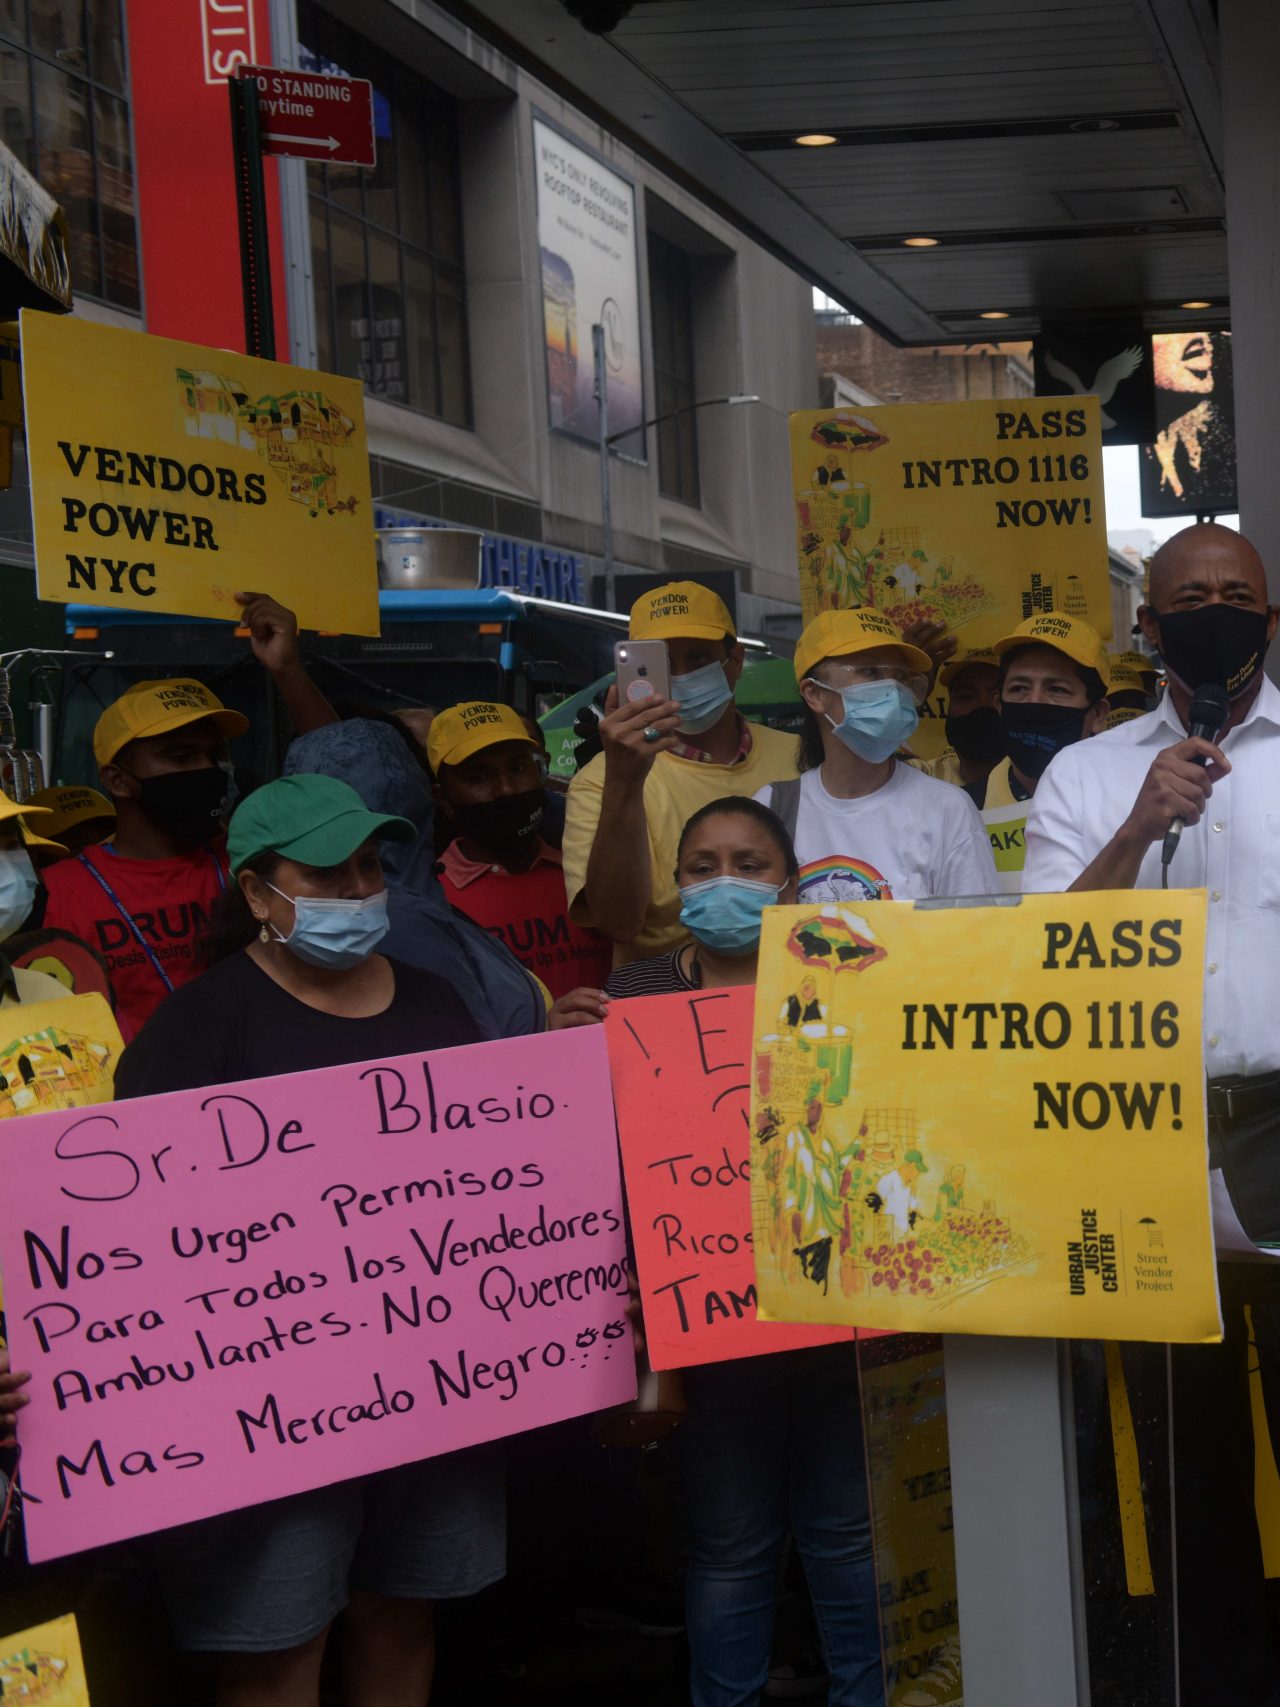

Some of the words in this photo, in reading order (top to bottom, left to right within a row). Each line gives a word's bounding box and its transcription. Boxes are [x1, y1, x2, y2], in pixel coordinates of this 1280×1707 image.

[273, 78, 351, 102] STANDING
[258, 98, 314, 117] nytime
[996, 410, 1087, 440] PASS
[57, 441, 267, 505] VENDORS
[902, 456, 1020, 489] INTRO
[1029, 454, 1090, 483] 1116
[61, 497, 219, 551] POWER
[996, 498, 1092, 528] NOW!
[66, 554, 156, 596] NYC
[480, 535, 588, 605] THEATRE
[650, 593, 689, 607] VENDOR
[650, 605, 689, 620] POWER!
[1023, 591, 1032, 621] RBAN
[1043, 586, 1054, 613] ENTER
[856, 613, 892, 627] VENDOR
[861, 623, 896, 638] POWER!
[1030, 626, 1067, 639] POWER!
[1035, 617, 1073, 631] VENDOR
[459, 704, 499, 719] VENDOR
[463, 714, 503, 731] POWER!
[1042, 919, 1184, 969] PASS
[102, 948, 146, 971] Desis
[902, 1001, 1072, 1050] INTRO
[1086, 1000, 1180, 1049] 1116
[1033, 1082, 1184, 1131] NOW!
[54, 1115, 198, 1201] Sr.
[200, 1095, 315, 1171] De
[24, 1225, 143, 1290] Nos
[171, 1211, 296, 1263] Urgen
[321, 1162, 545, 1227] Permisos
[1081, 1208, 1100, 1275] JUSTICE
[1067, 1242, 1086, 1296] URBAN
[1099, 1234, 1118, 1293] CENTER
[1134, 1266, 1173, 1278] Vendor
[1136, 1252, 1168, 1264] Street
[23, 1302, 164, 1354] Para
[185, 1268, 328, 1315] Todos
[344, 1246, 406, 1284] los
[410, 1204, 620, 1276] Vendedores
[1136, 1279, 1174, 1292] Project
[382, 1285, 453, 1334] No
[478, 1256, 630, 1321] Queremos
[55, 1440, 205, 1499] Mas
[235, 1372, 415, 1453] Mercado
